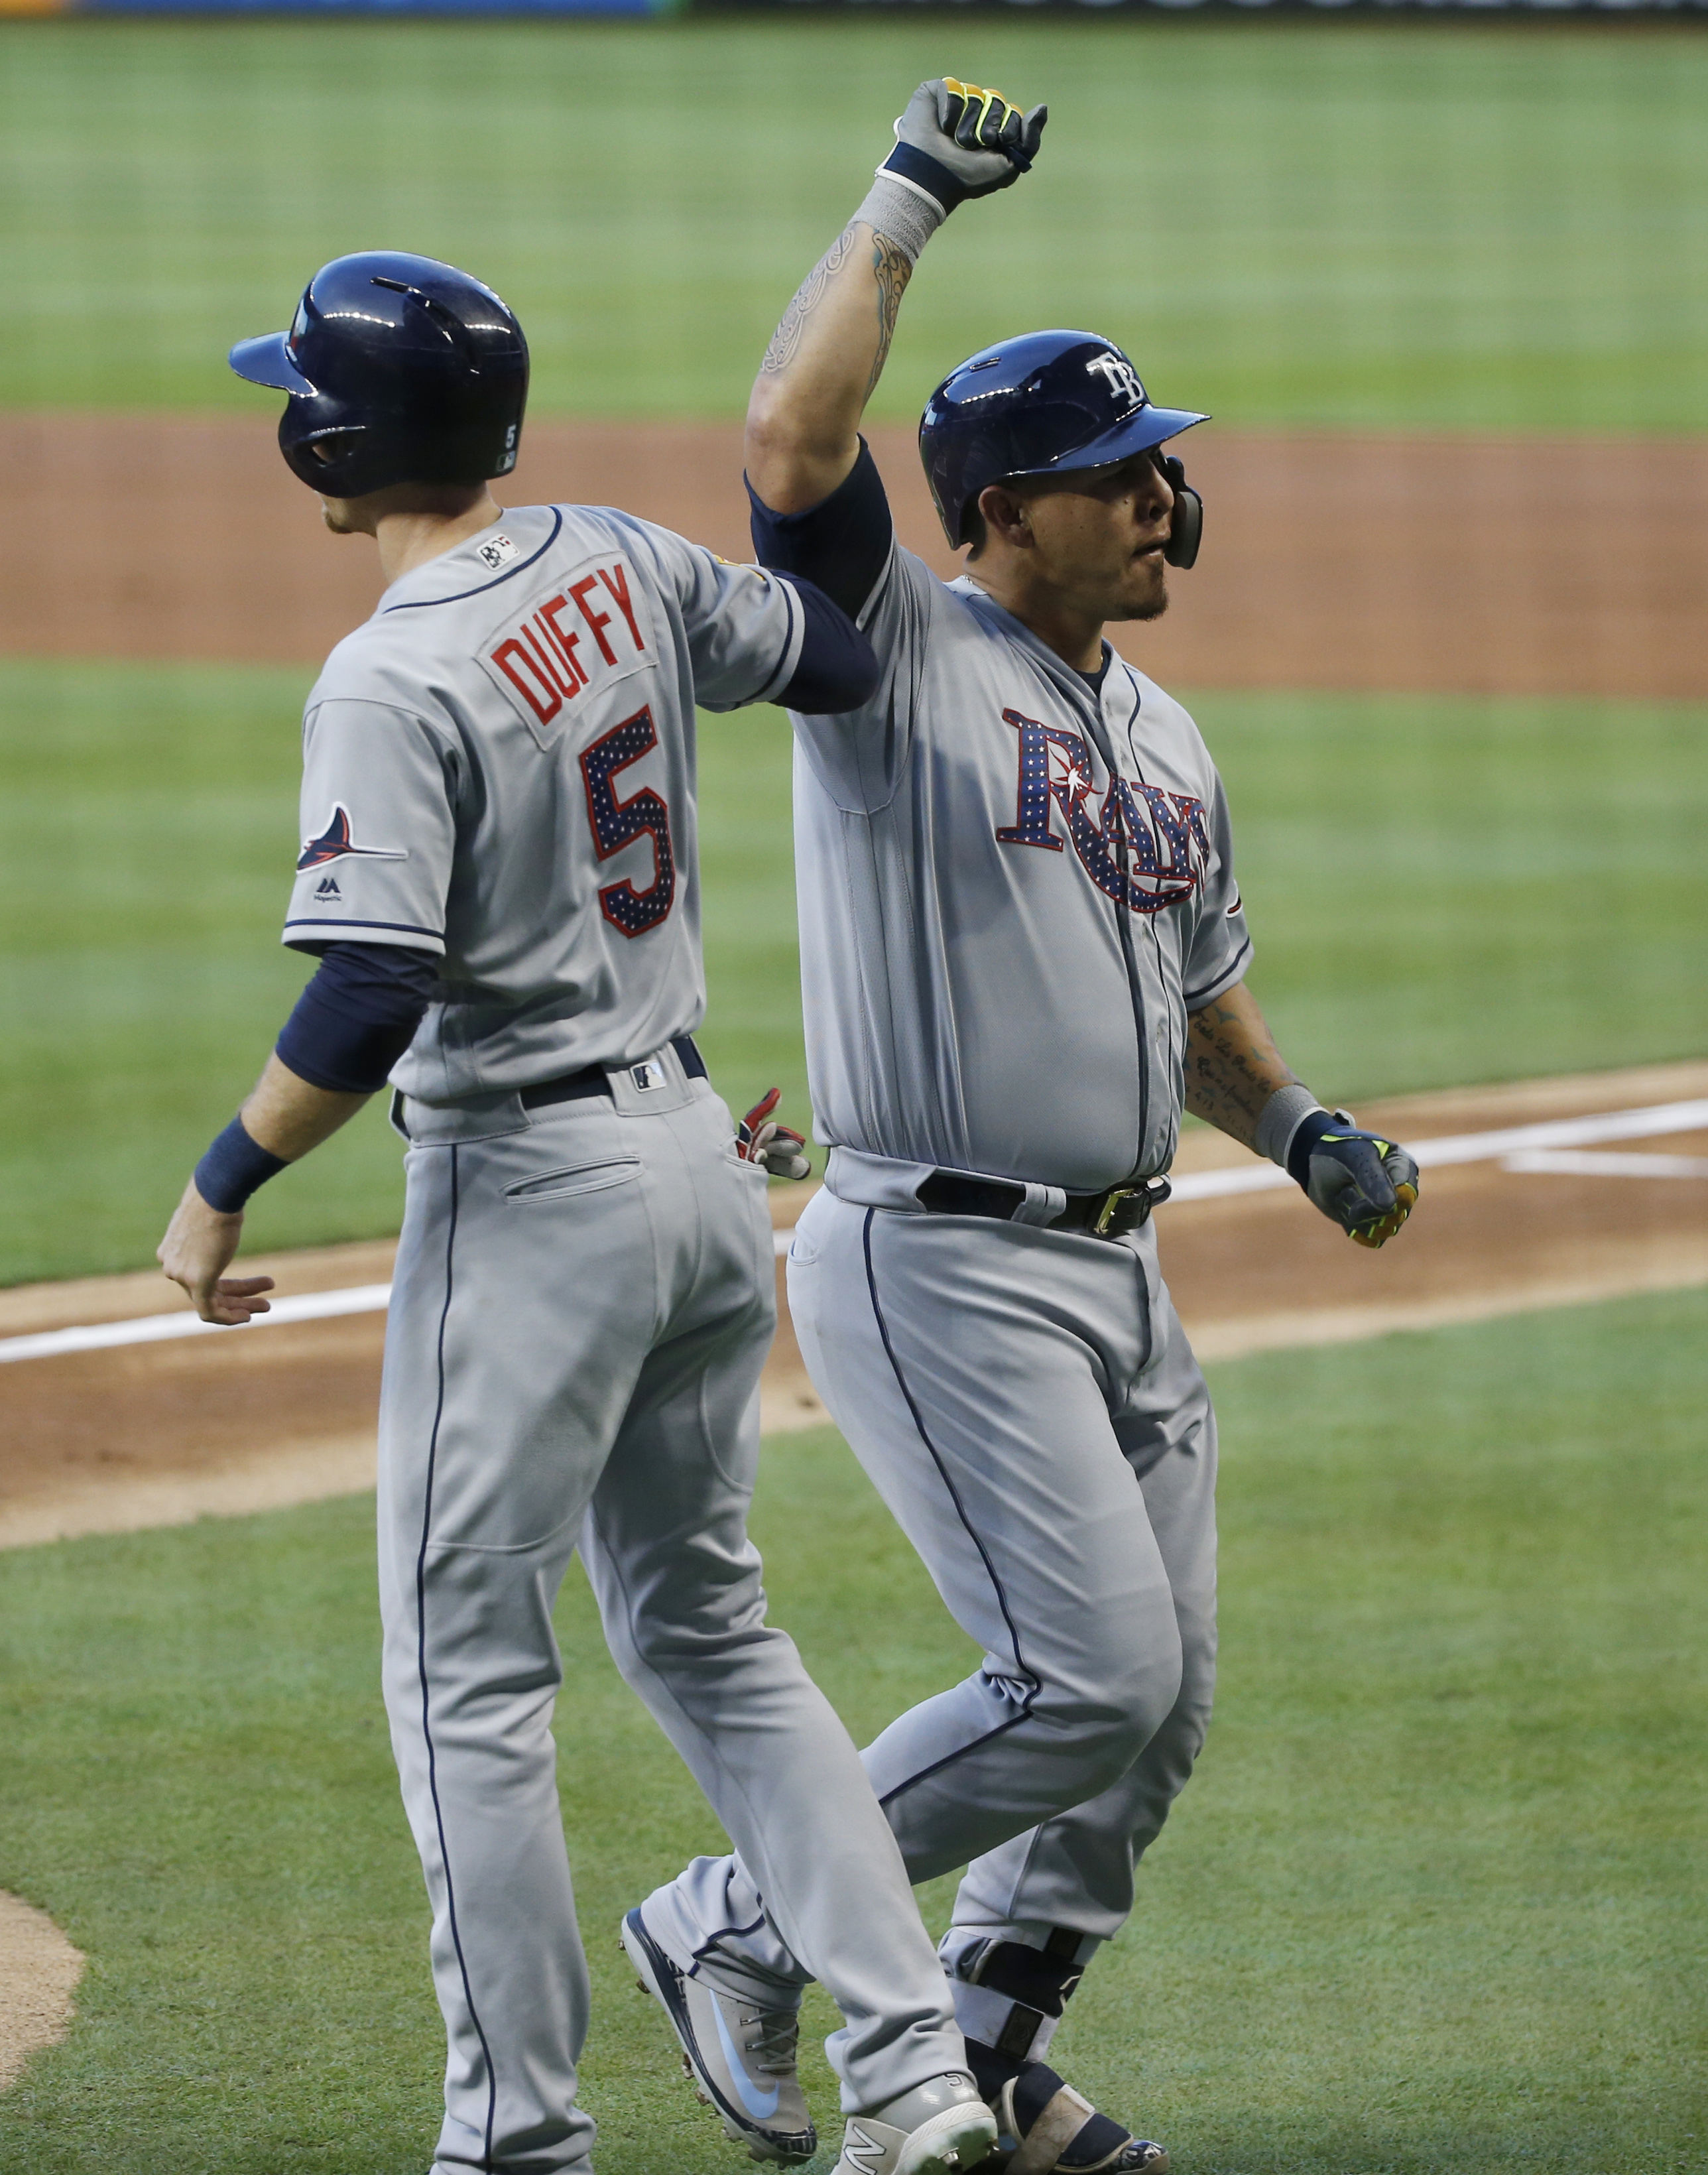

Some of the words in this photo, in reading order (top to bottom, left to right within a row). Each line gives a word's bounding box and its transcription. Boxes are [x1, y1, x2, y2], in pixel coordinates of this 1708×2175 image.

[1085, 351, 1144, 406] TB
[505, 424, 517, 449] 5
[491, 564, 645, 726] DUFFY
[579, 704, 676, 939] 5
